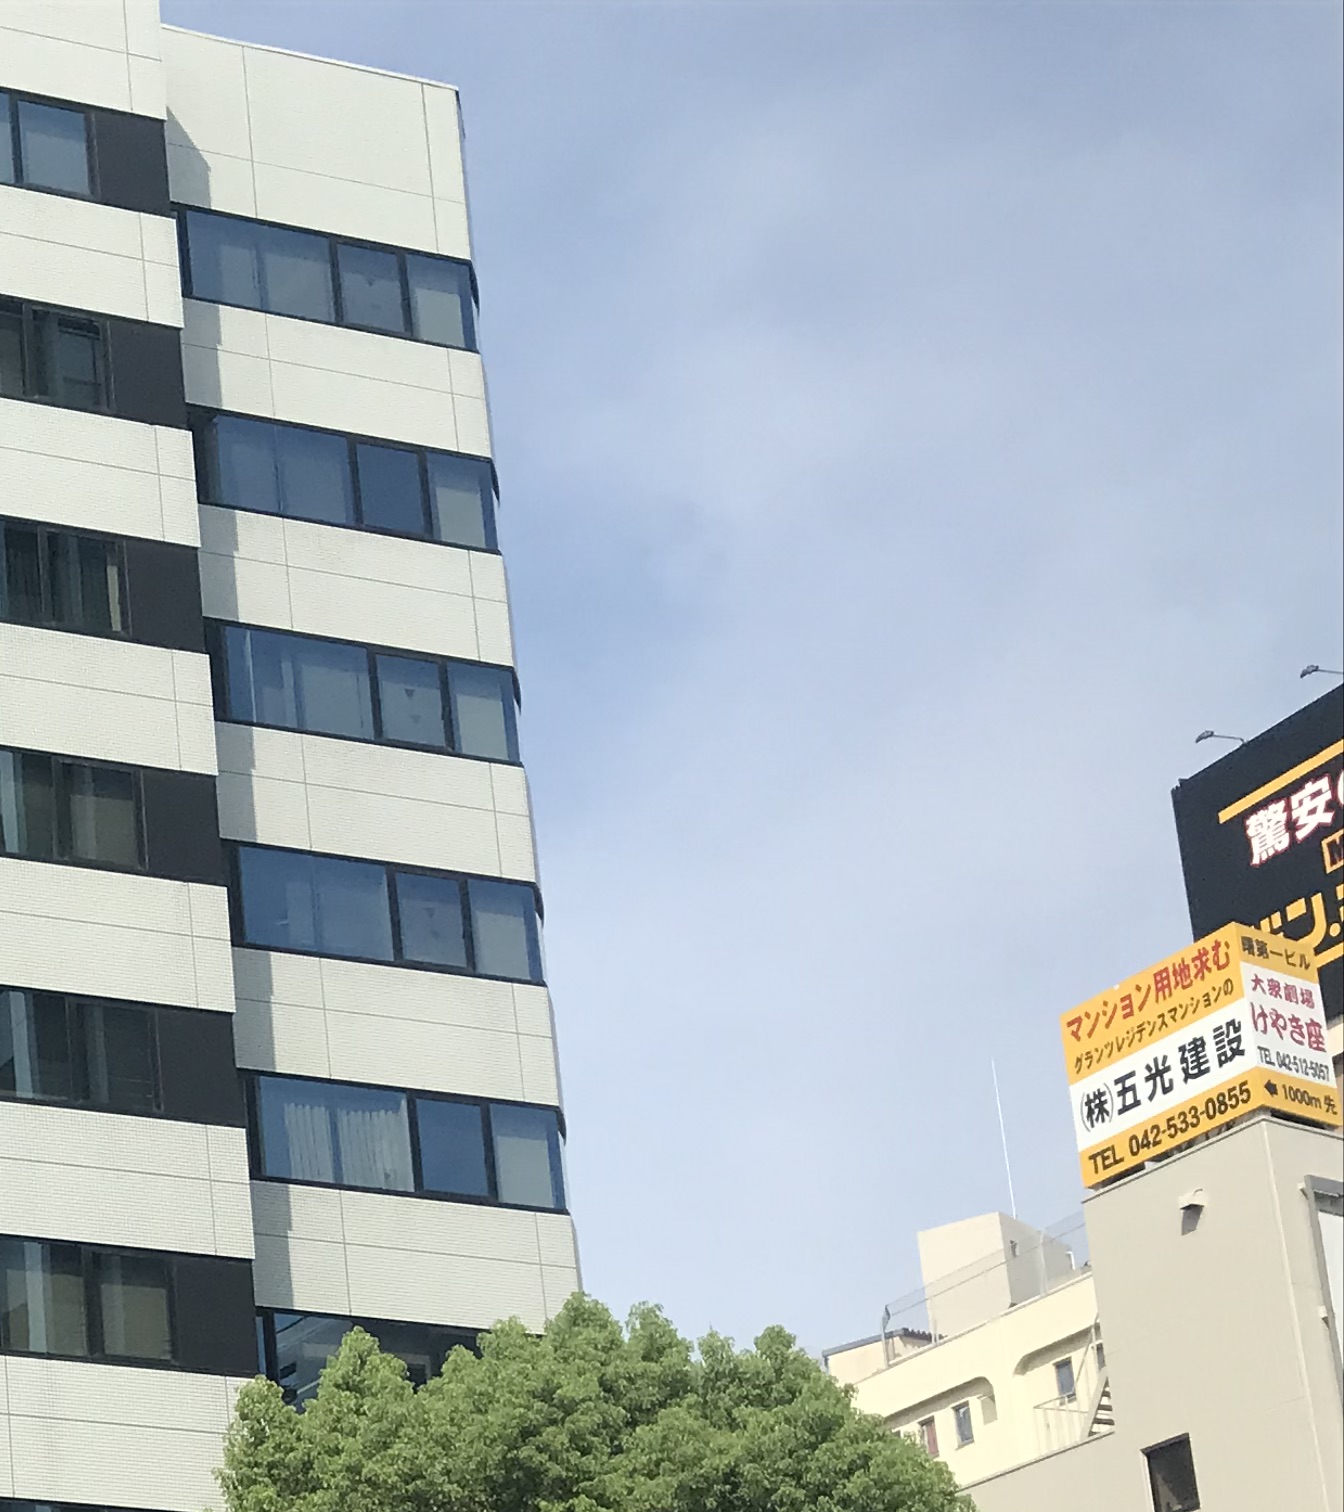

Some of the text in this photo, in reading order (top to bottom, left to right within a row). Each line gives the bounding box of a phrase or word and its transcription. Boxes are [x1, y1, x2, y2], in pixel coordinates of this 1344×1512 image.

[1066, 938, 1231, 1043] マンション用地求む
[1250, 1001, 1327, 1053] けやき座
[1257, 1045, 1330, 1082] TEL 042-512-5057
[1088, 1080, 1252, 1175] TEL 042-533-0855
